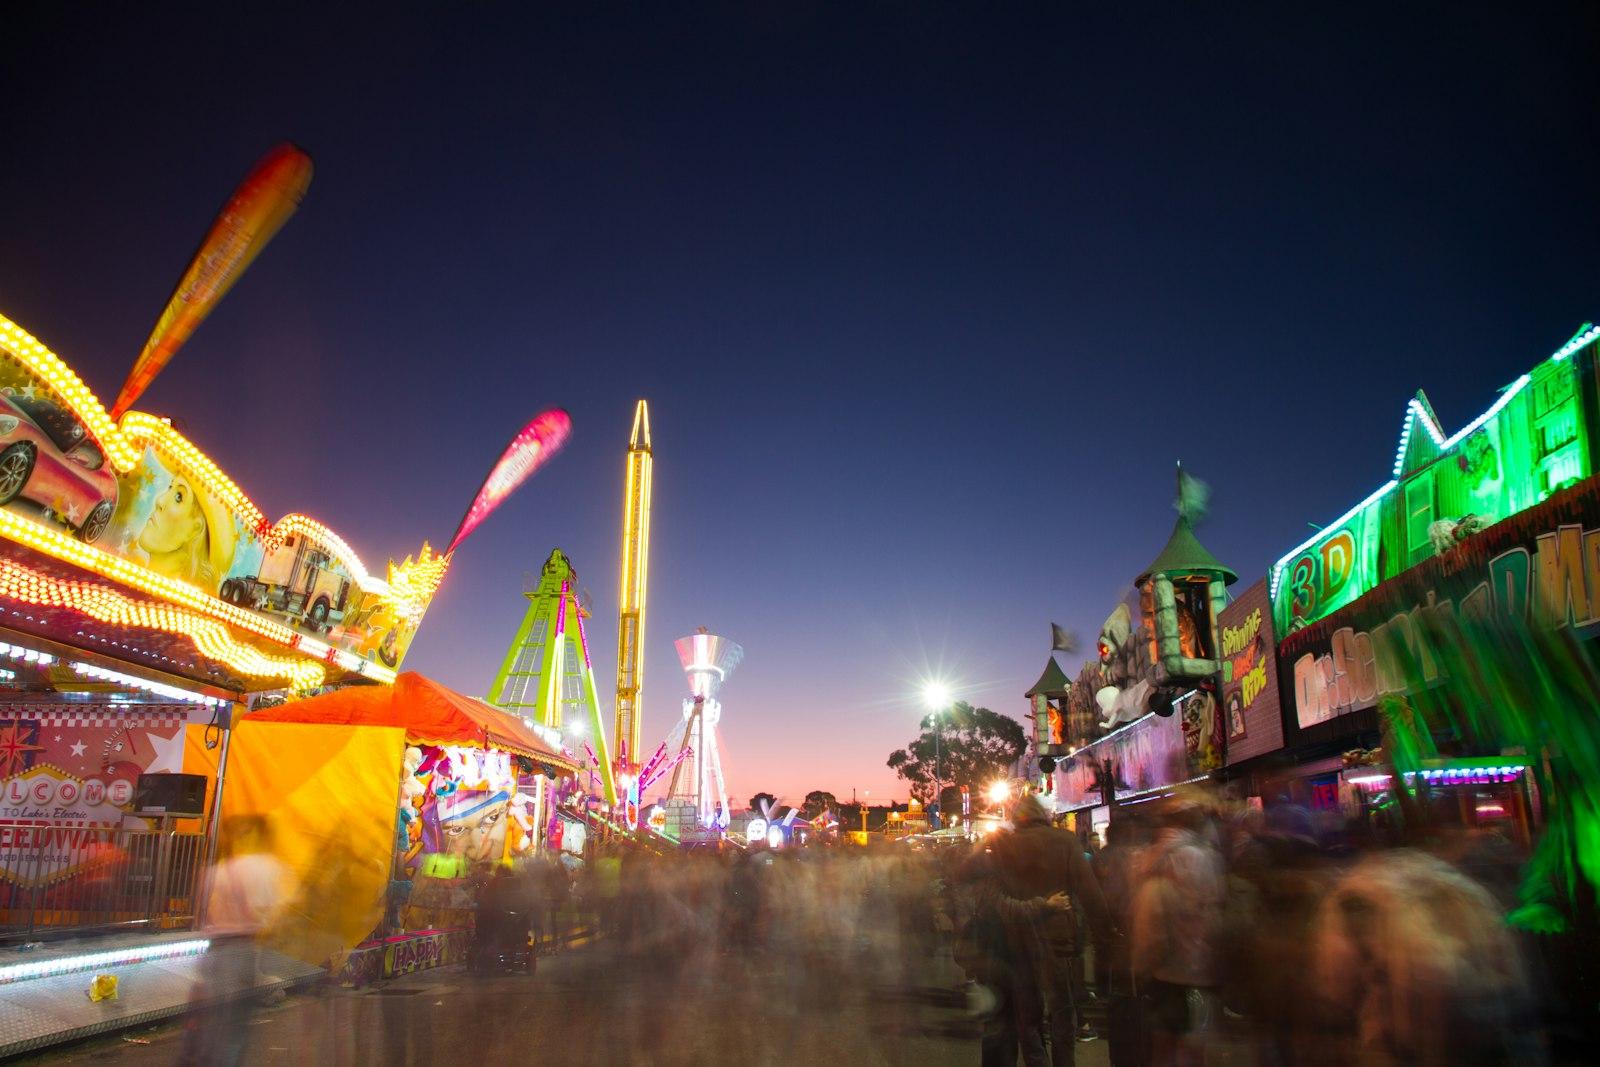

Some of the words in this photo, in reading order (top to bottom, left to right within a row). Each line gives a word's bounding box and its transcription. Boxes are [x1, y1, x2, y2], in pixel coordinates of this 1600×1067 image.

[1291, 530, 1357, 620] 3D
[3, 807, 19, 817] TO
[53, 807, 87, 819] Electric
[393, 937, 443, 972] HAPPY
